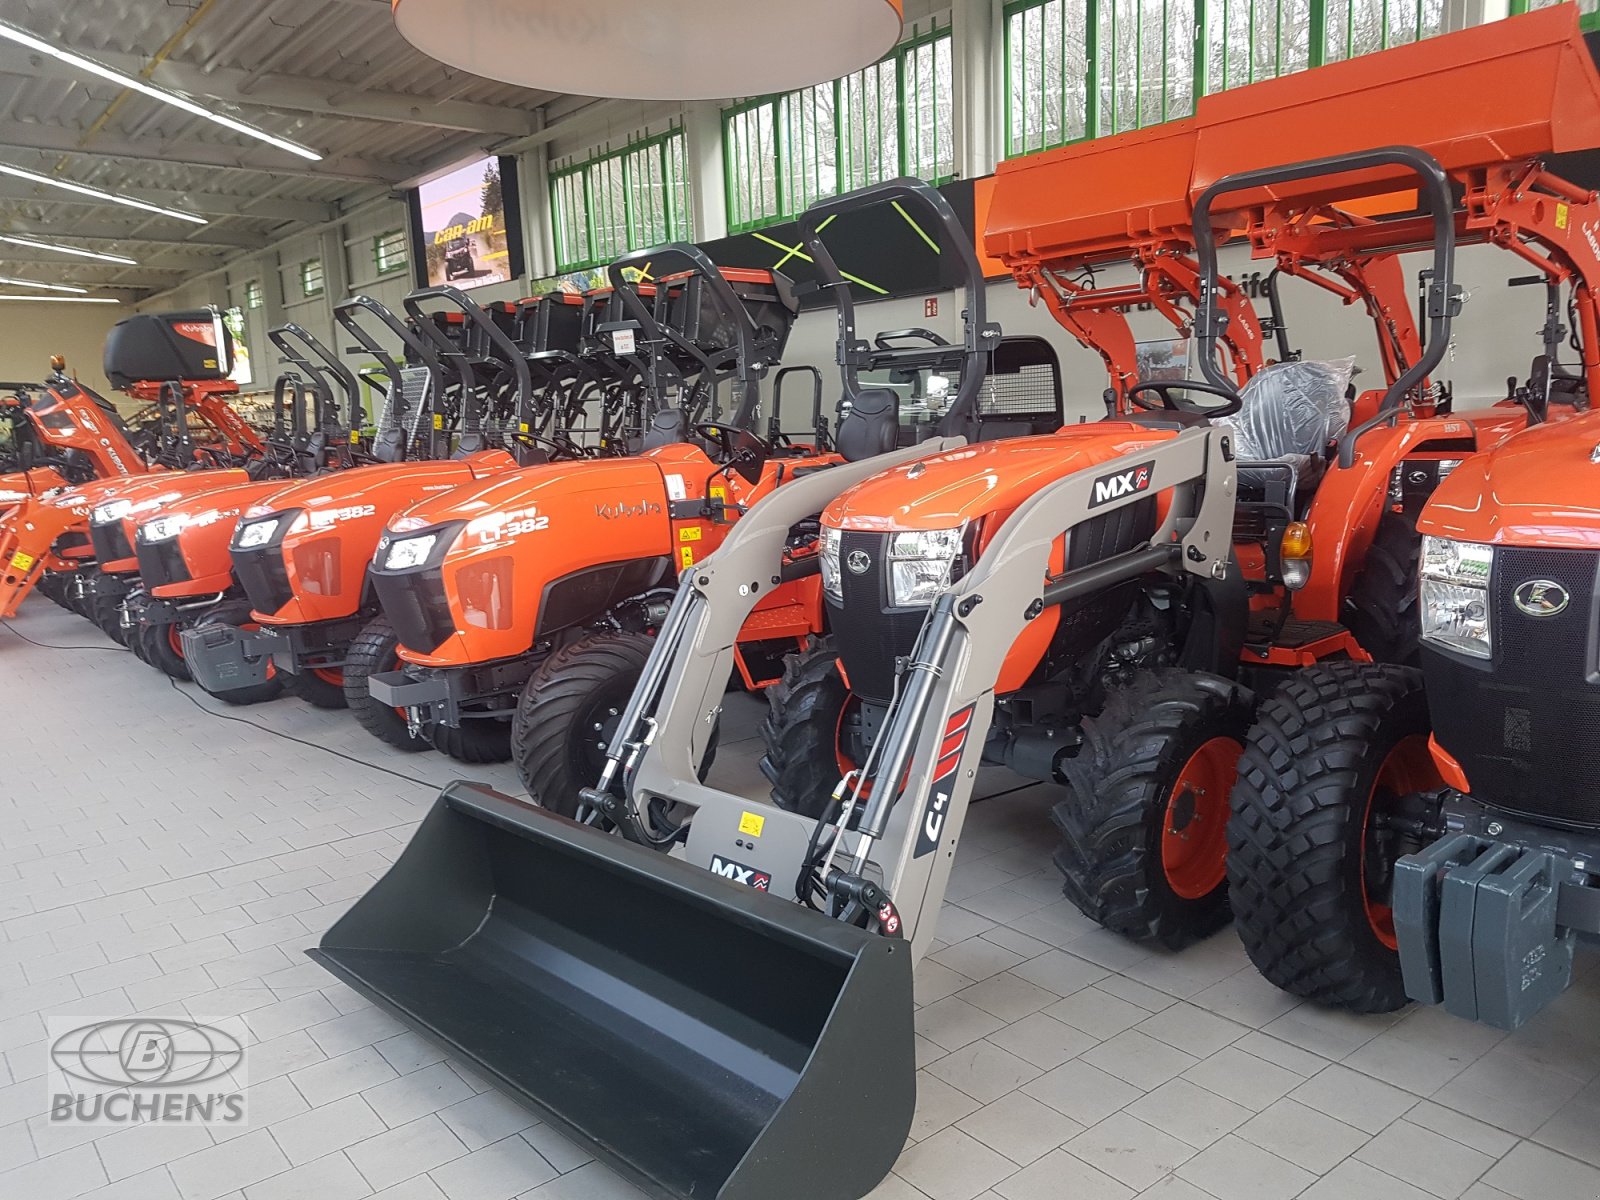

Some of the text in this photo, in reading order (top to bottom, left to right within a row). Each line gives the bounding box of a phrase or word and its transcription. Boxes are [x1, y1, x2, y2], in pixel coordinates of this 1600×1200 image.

[1226, 271, 1273, 298] ife
[1443, 423, 1460, 433] HST
[1095, 470, 1135, 503] MX
[594, 499, 661, 521] Kubota
[925, 791, 948, 842] C4
[711, 857, 755, 885] MX
